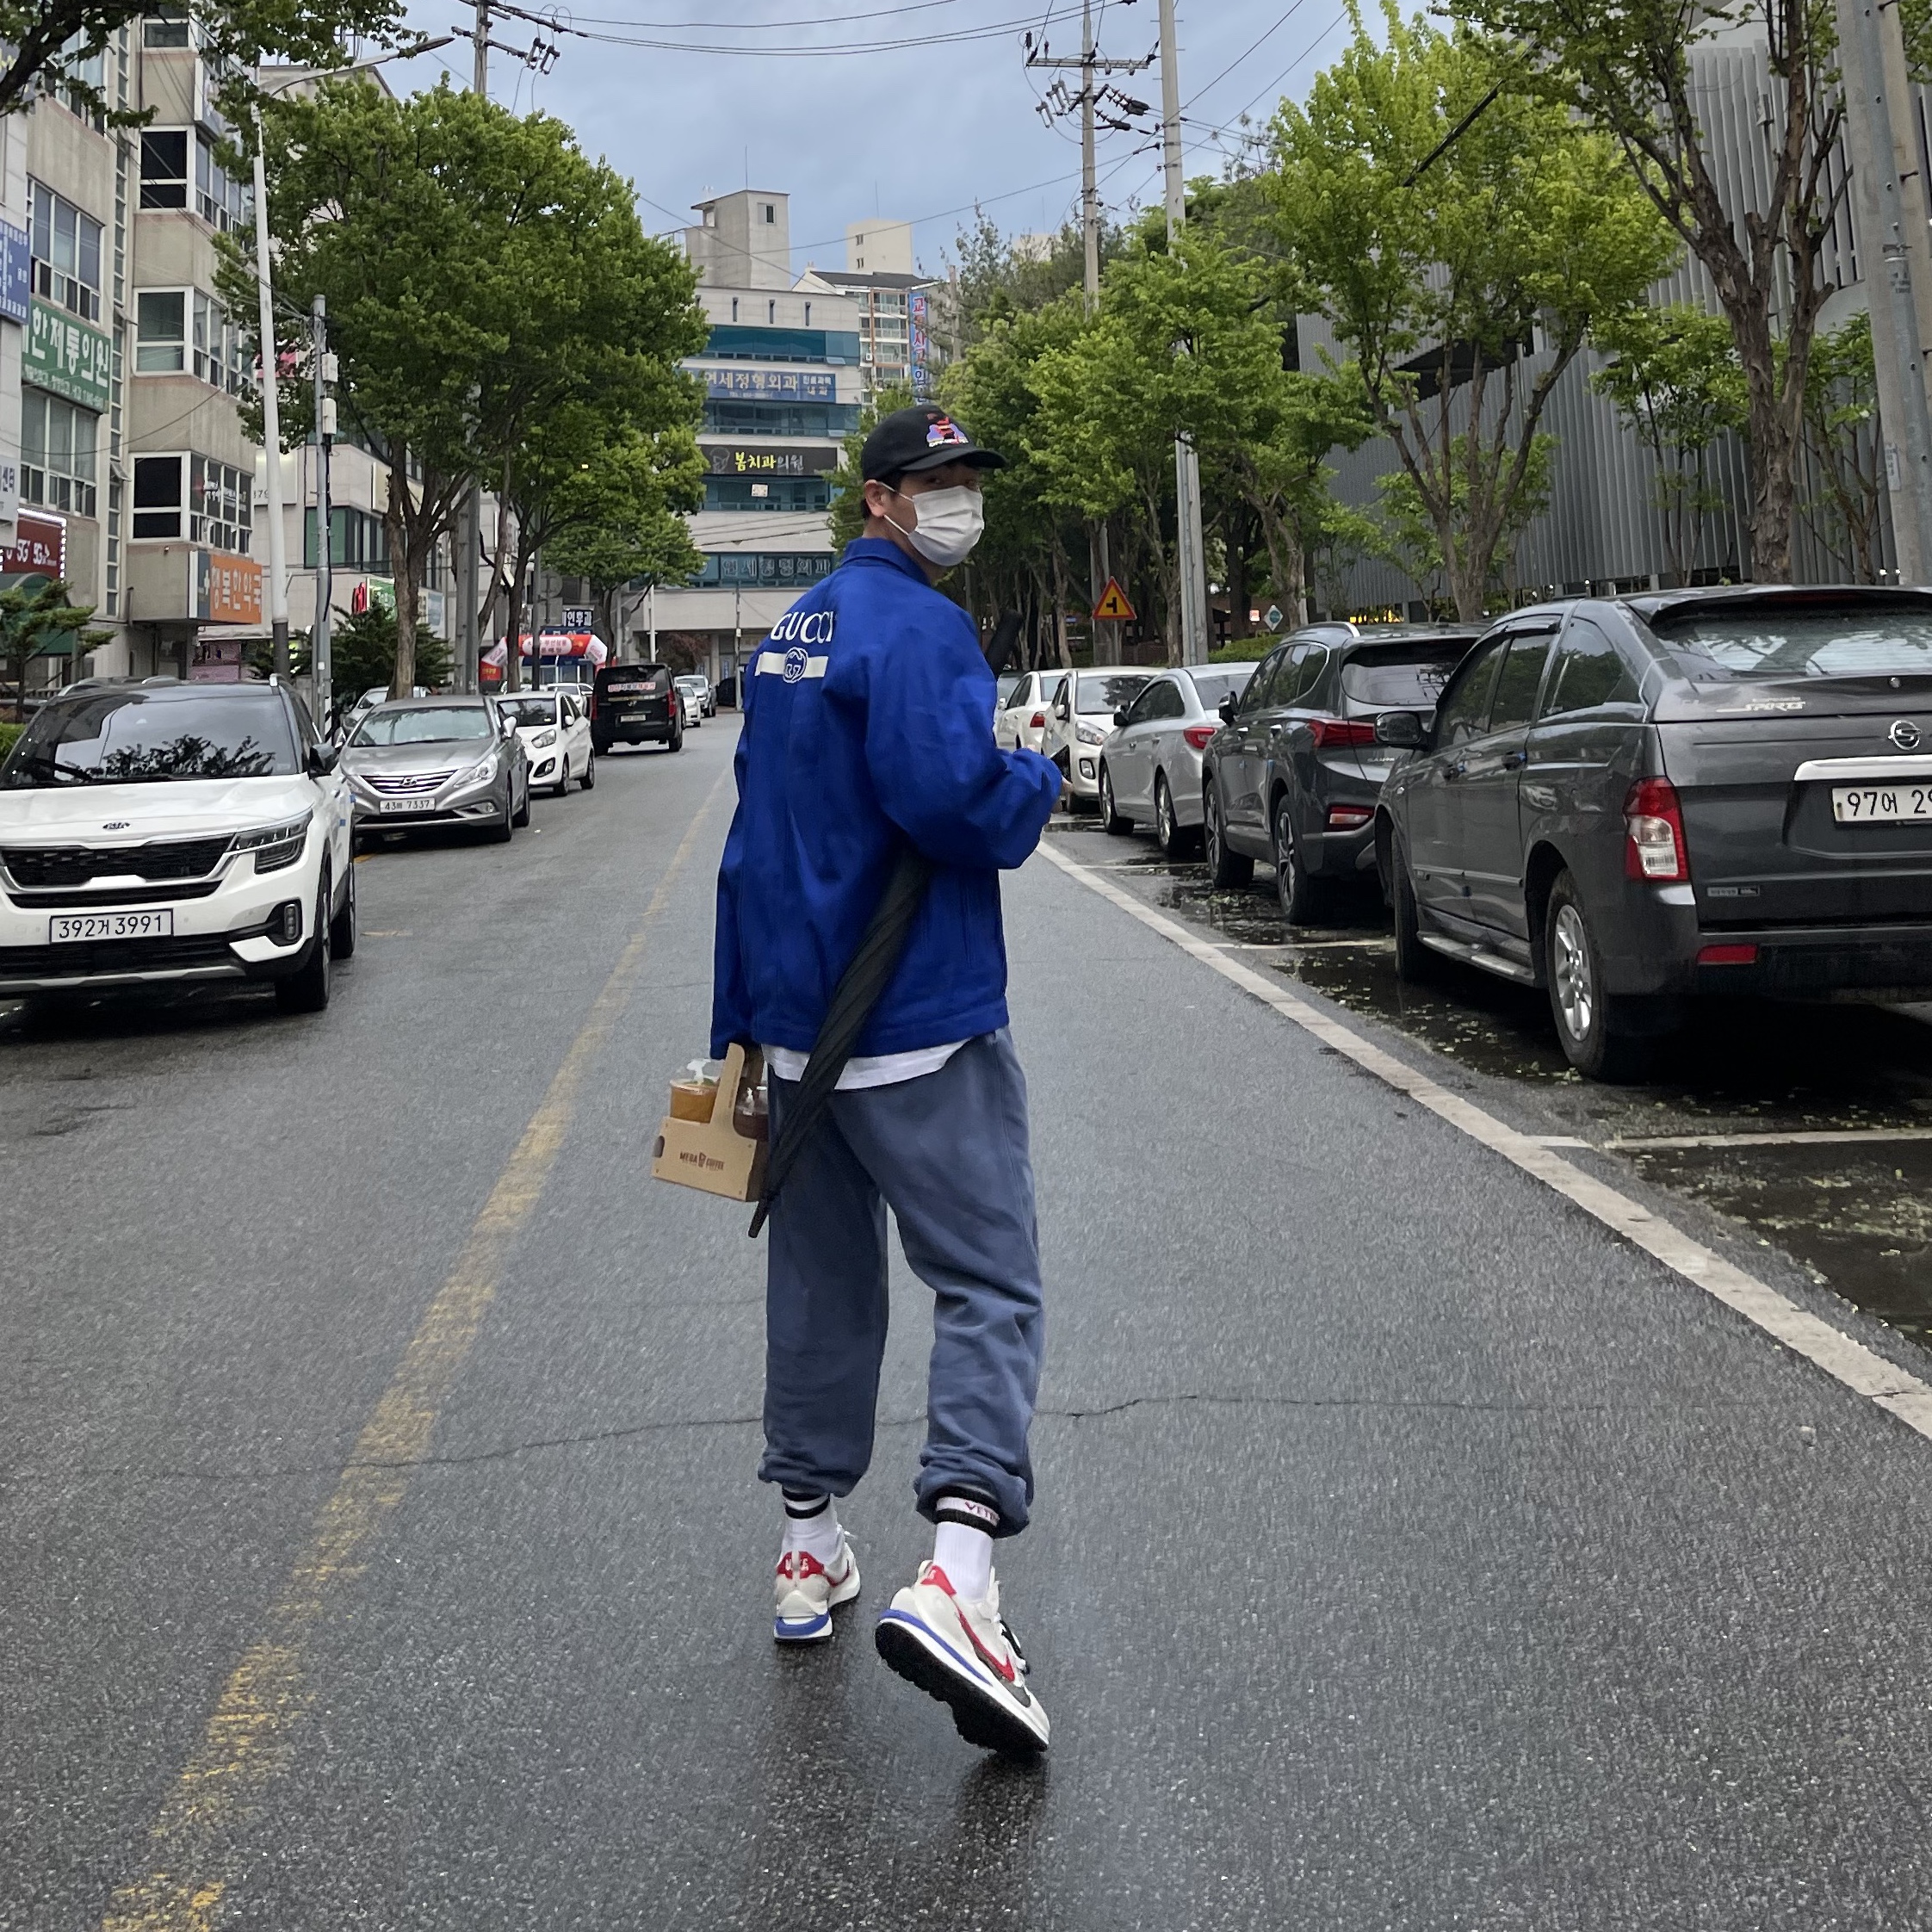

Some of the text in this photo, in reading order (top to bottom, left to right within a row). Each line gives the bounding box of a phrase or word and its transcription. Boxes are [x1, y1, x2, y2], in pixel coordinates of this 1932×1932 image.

[771, 611, 834, 644] GUCCI
[1847, 792, 1898, 816] 97어
[115, 914, 162, 935] 3991
